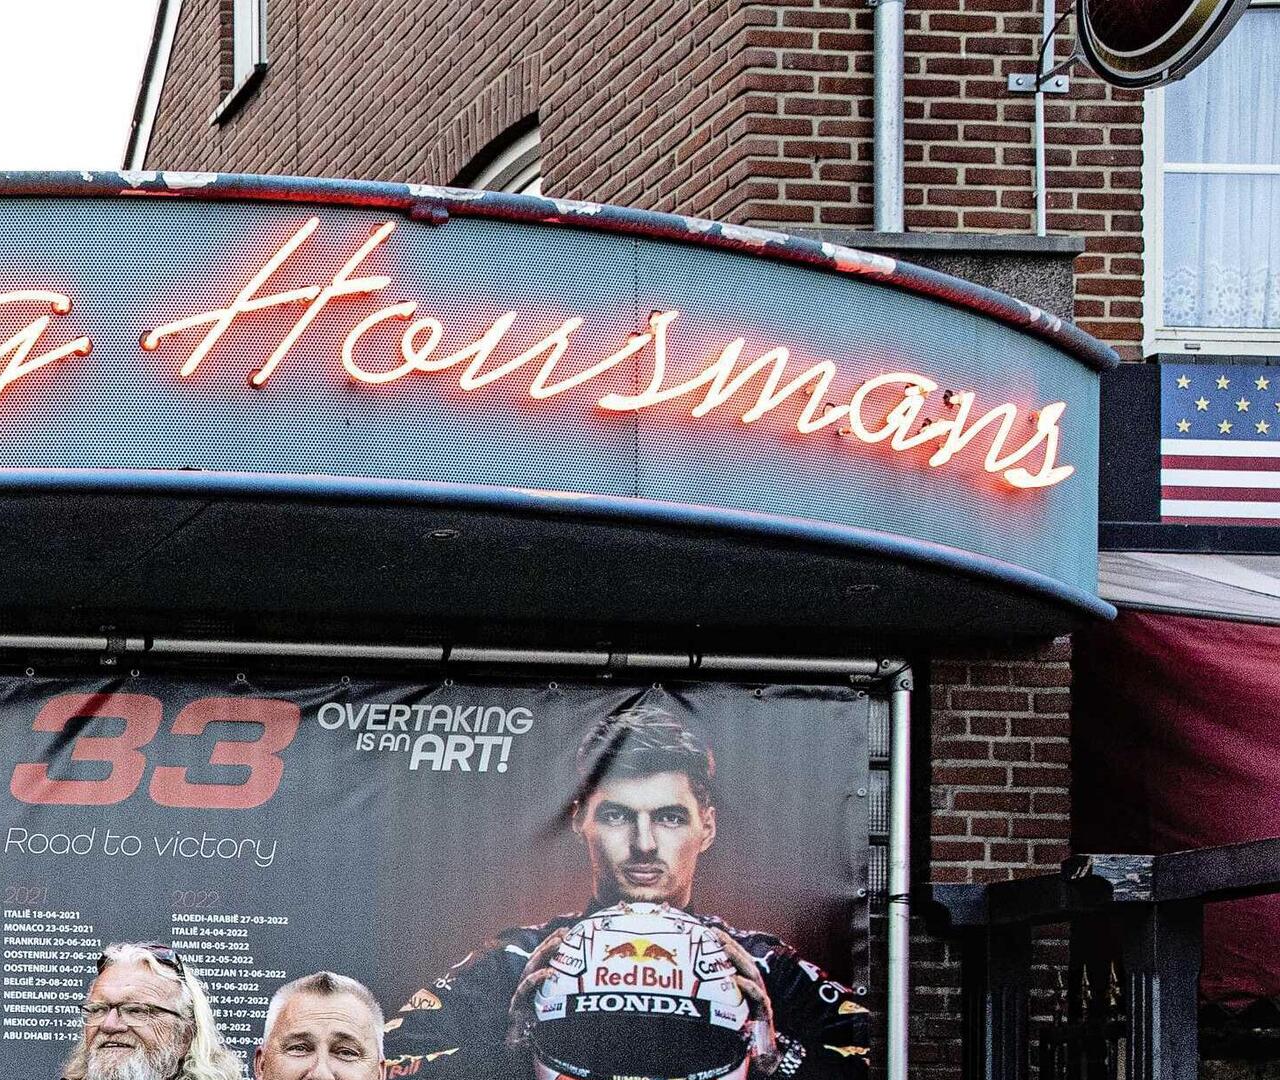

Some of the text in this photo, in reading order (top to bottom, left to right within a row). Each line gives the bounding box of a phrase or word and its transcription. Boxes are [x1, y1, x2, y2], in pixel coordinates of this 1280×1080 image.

[139, 215, 1075, 489] Housmans
[317, 701, 534, 735] OVERTAKING
[9, 691, 301, 809] 33
[357, 733, 375, 751] IS
[409, 734, 512, 774] ART!
[4, 827, 278, 867] Road to victory
[4, 886, 48, 903] 2021
[172, 891, 219, 907] 2022
[4, 909, 80, 919] ITALIË 18-04-2021
[172, 913, 288, 925] SAOEDI-ARABIË 27-03-2022
[4, 923, 93, 933] MONACO 23-05-2021
[172, 926, 248, 937] ITALIË 24-04-2022
[4, 937, 101, 946] FRANKRIJK 20-06-2021
[172, 941, 249, 950] MIAMI 08-05-2022
[4, 951, 102, 960] OOSTENRIJK 27-06-202
[178, 954, 253, 964] PANJE 22-05-2022
[4, 964, 98, 974] OOSTENRIJK 04-07-20
[239, 970, 286, 978] 12-06-2022
[4, 976, 83, 987] BELGIË 29-08-2021
[595, 965, 683, 990] Red Bull
[211, 982, 259, 991] 19-06-2022
[4, 991, 87, 1000] NEDERLAND 05-09-
[220, 996, 268, 1005] 24-07-2022
[4, 1005, 81, 1014] VERENIGDE STATE
[575, 995, 701, 1017] HONDA
[4, 1018, 83, 1028] MEXICO 07-11-202
[3, 1032, 82, 1041] ABU DHABI 12-12-
[225, 1037, 264, 1045] 04-09-20
